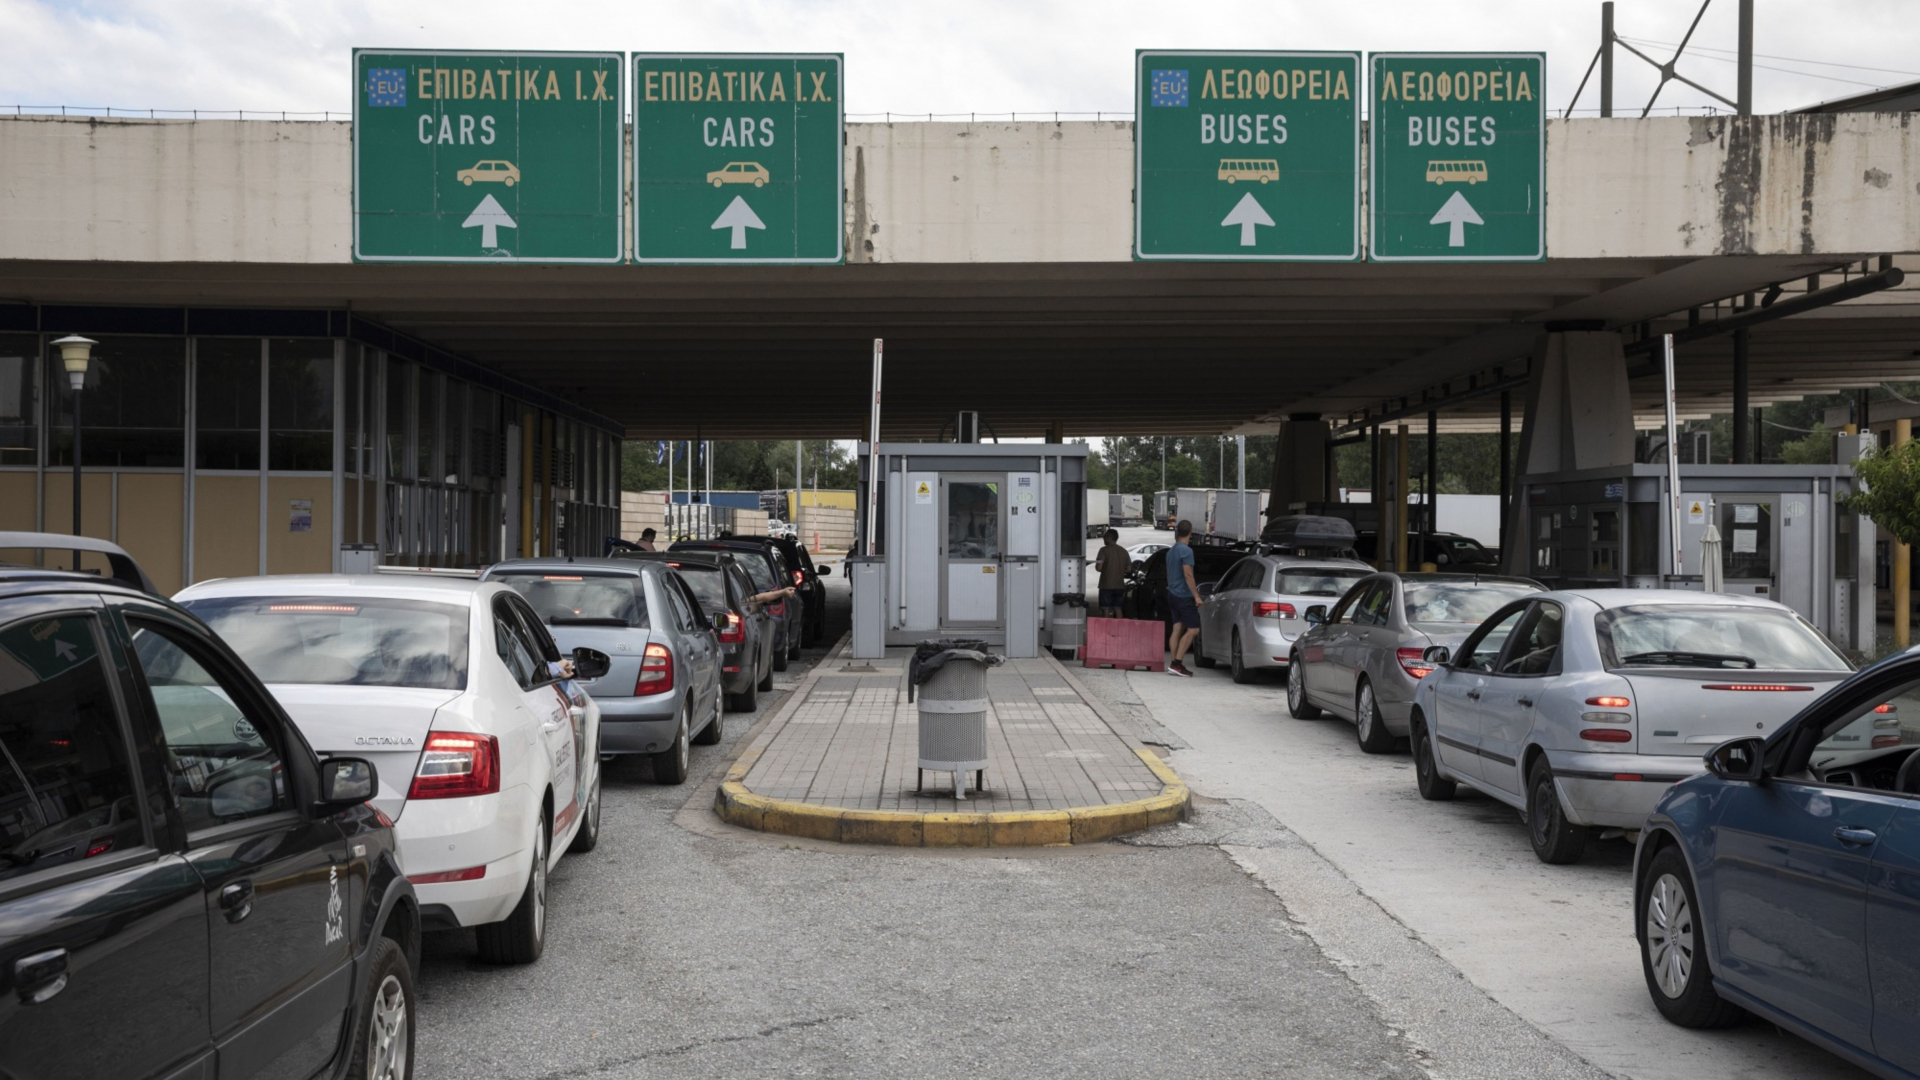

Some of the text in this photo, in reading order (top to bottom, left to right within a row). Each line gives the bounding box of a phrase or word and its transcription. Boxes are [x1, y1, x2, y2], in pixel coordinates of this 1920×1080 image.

[378, 81, 398, 94] EU
[418, 68, 561, 100] ΕΠΙΒΑΤΙΚΑ
[645, 71, 786, 102] ΕΠΙΒΑΤΙΚΑ
[1160, 81, 1181, 95] EU
[1201, 69, 1350, 100] ΛΕΩΦΟΡΕΙΑ
[1381, 71, 1532, 101] ΛΕΩΦΟΡΕΙΑ
[418, 114, 496, 145] CARS
[703, 117, 775, 147] CARS
[1201, 113, 1288, 144] BUSES
[1408, 116, 1496, 146] BUSES
[354, 736, 415, 746] OCTAVIA
